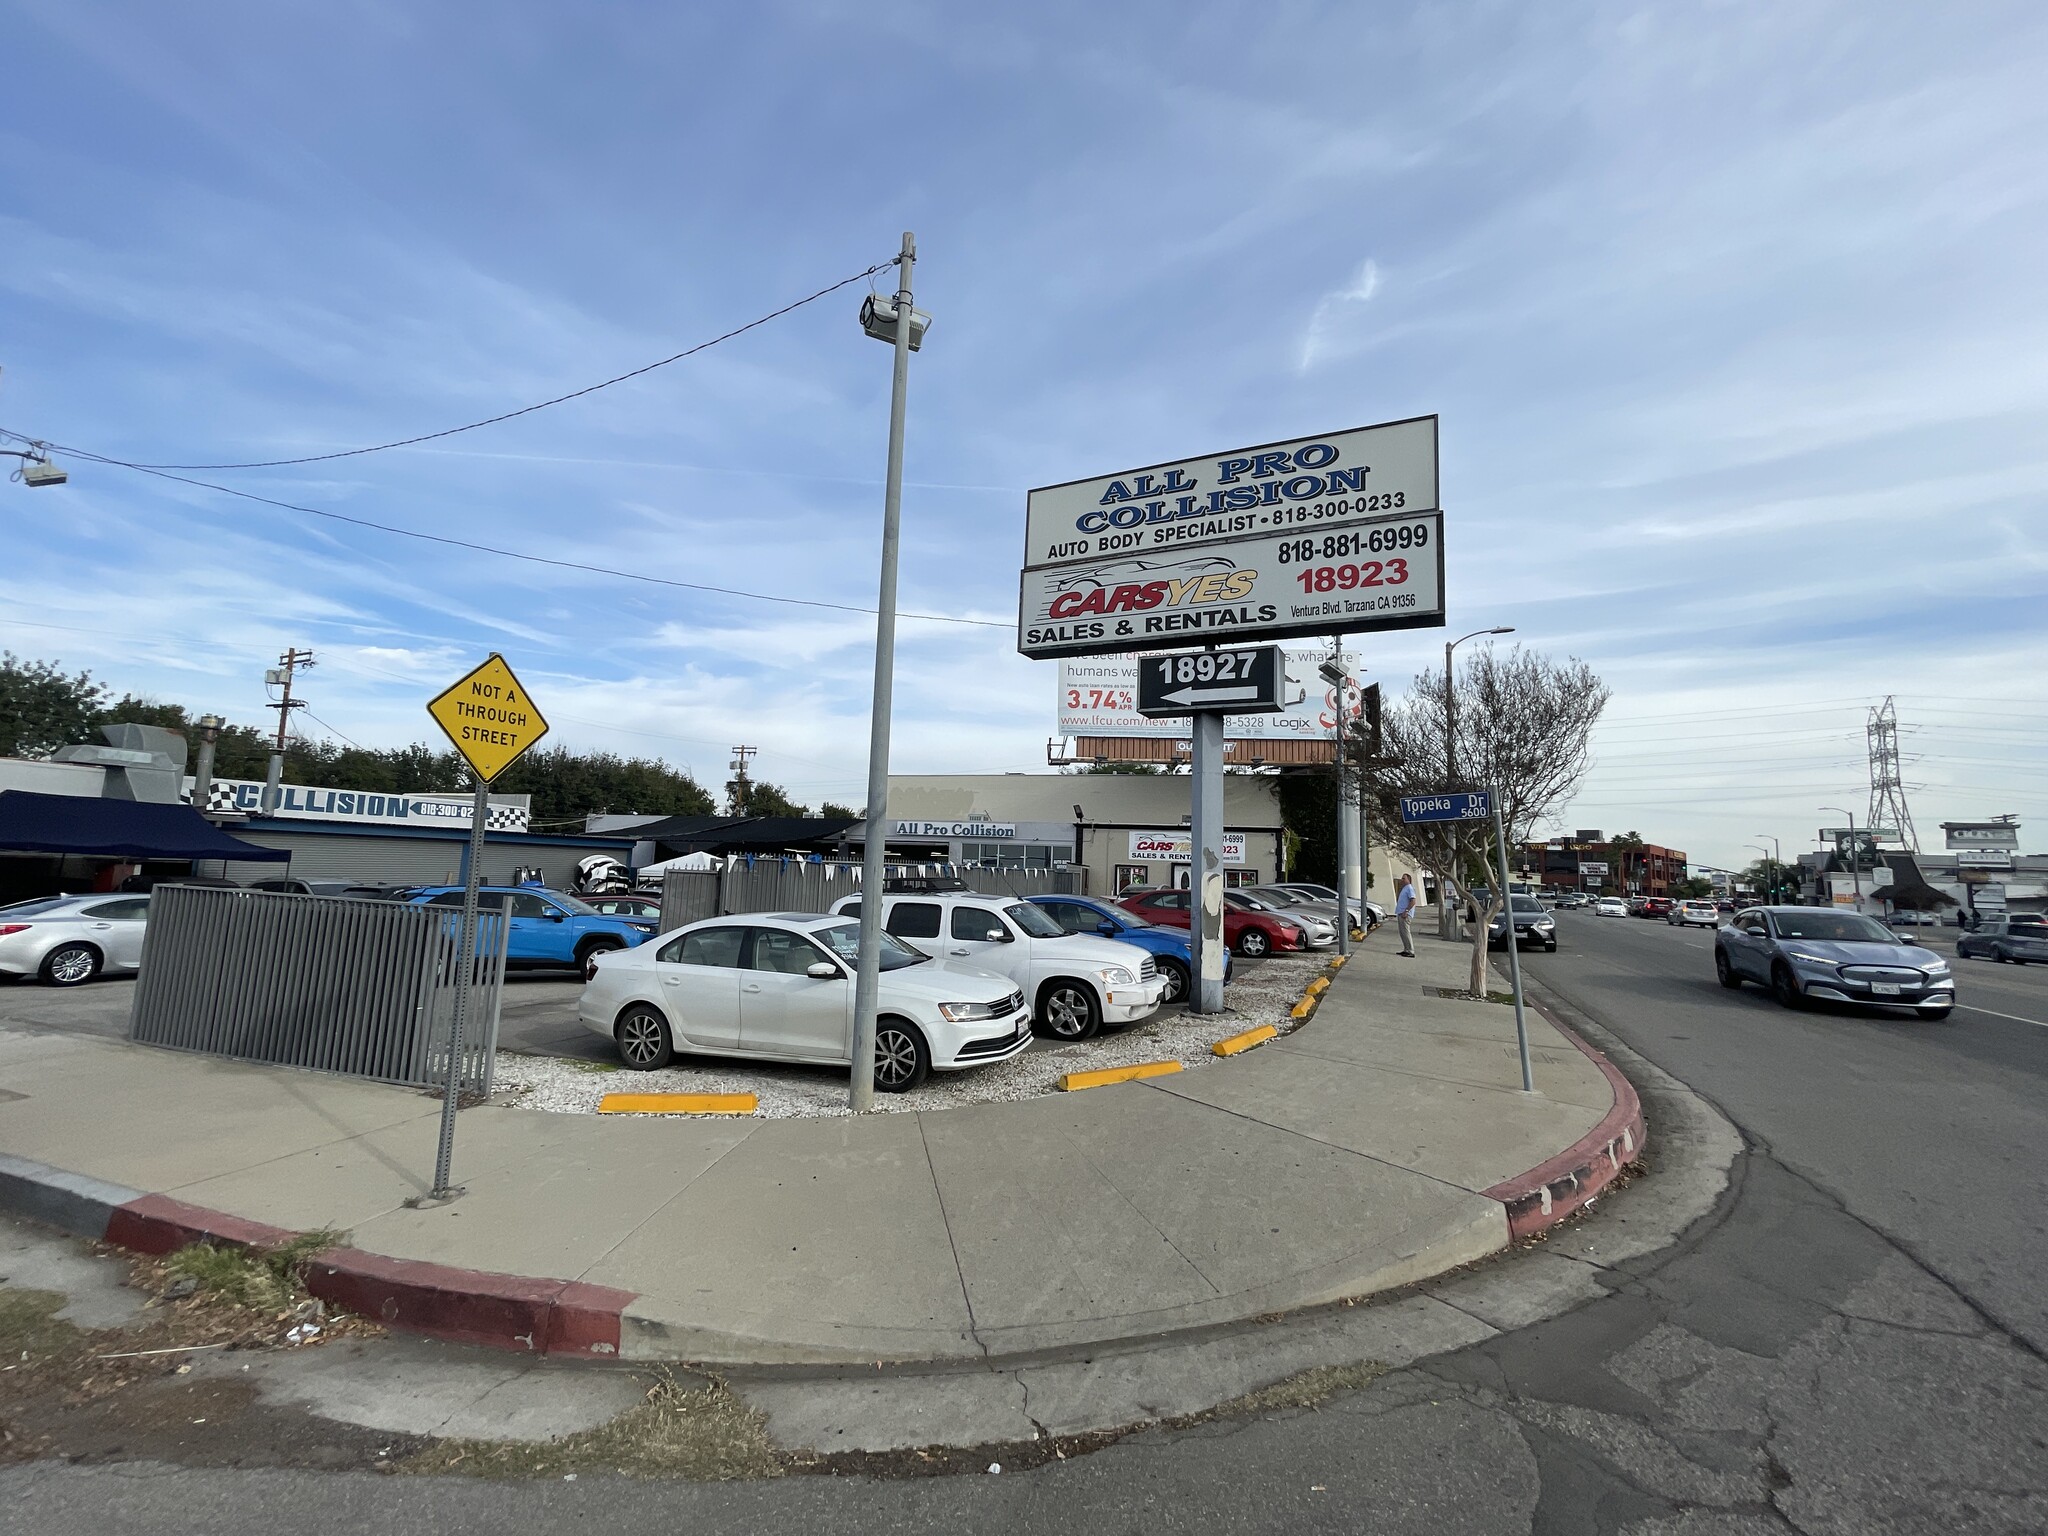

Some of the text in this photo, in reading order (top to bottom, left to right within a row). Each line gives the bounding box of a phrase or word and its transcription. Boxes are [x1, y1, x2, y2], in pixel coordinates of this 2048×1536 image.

[1100, 443, 1339, 505] ALL PRO
[1075, 465, 1371, 534] COLLISION
[1048, 492, 1406, 559] AUTO BODY SPECIALIST 818-300-0233
[1278, 524, 1428, 564] 818-881-6999
[1296, 558, 1409, 594] 18923
[1291, 593, 1416, 618] Ventura Blvd. Tarzana CA 91356
[1027, 604, 1277, 644] SALES & RENTALS
[1067, 665, 1118, 677] humans
[1158, 651, 1257, 684] 18927
[472, 681, 516, 703] NOT A
[457, 702, 526, 727] THROUGH
[1061, 715, 1168, 727] www.lfcu.com/new
[1273, 717, 1310, 730] Logix
[462, 726, 517, 747] STREET
[236, 783, 410, 818] CLLISION
[1404, 794, 1485, 814] Topeka Dr
[1461, 807, 1487, 818] 5600
[897, 823, 1015, 837] All Pro Collision
[1136, 841, 1191, 851] CARSYE
